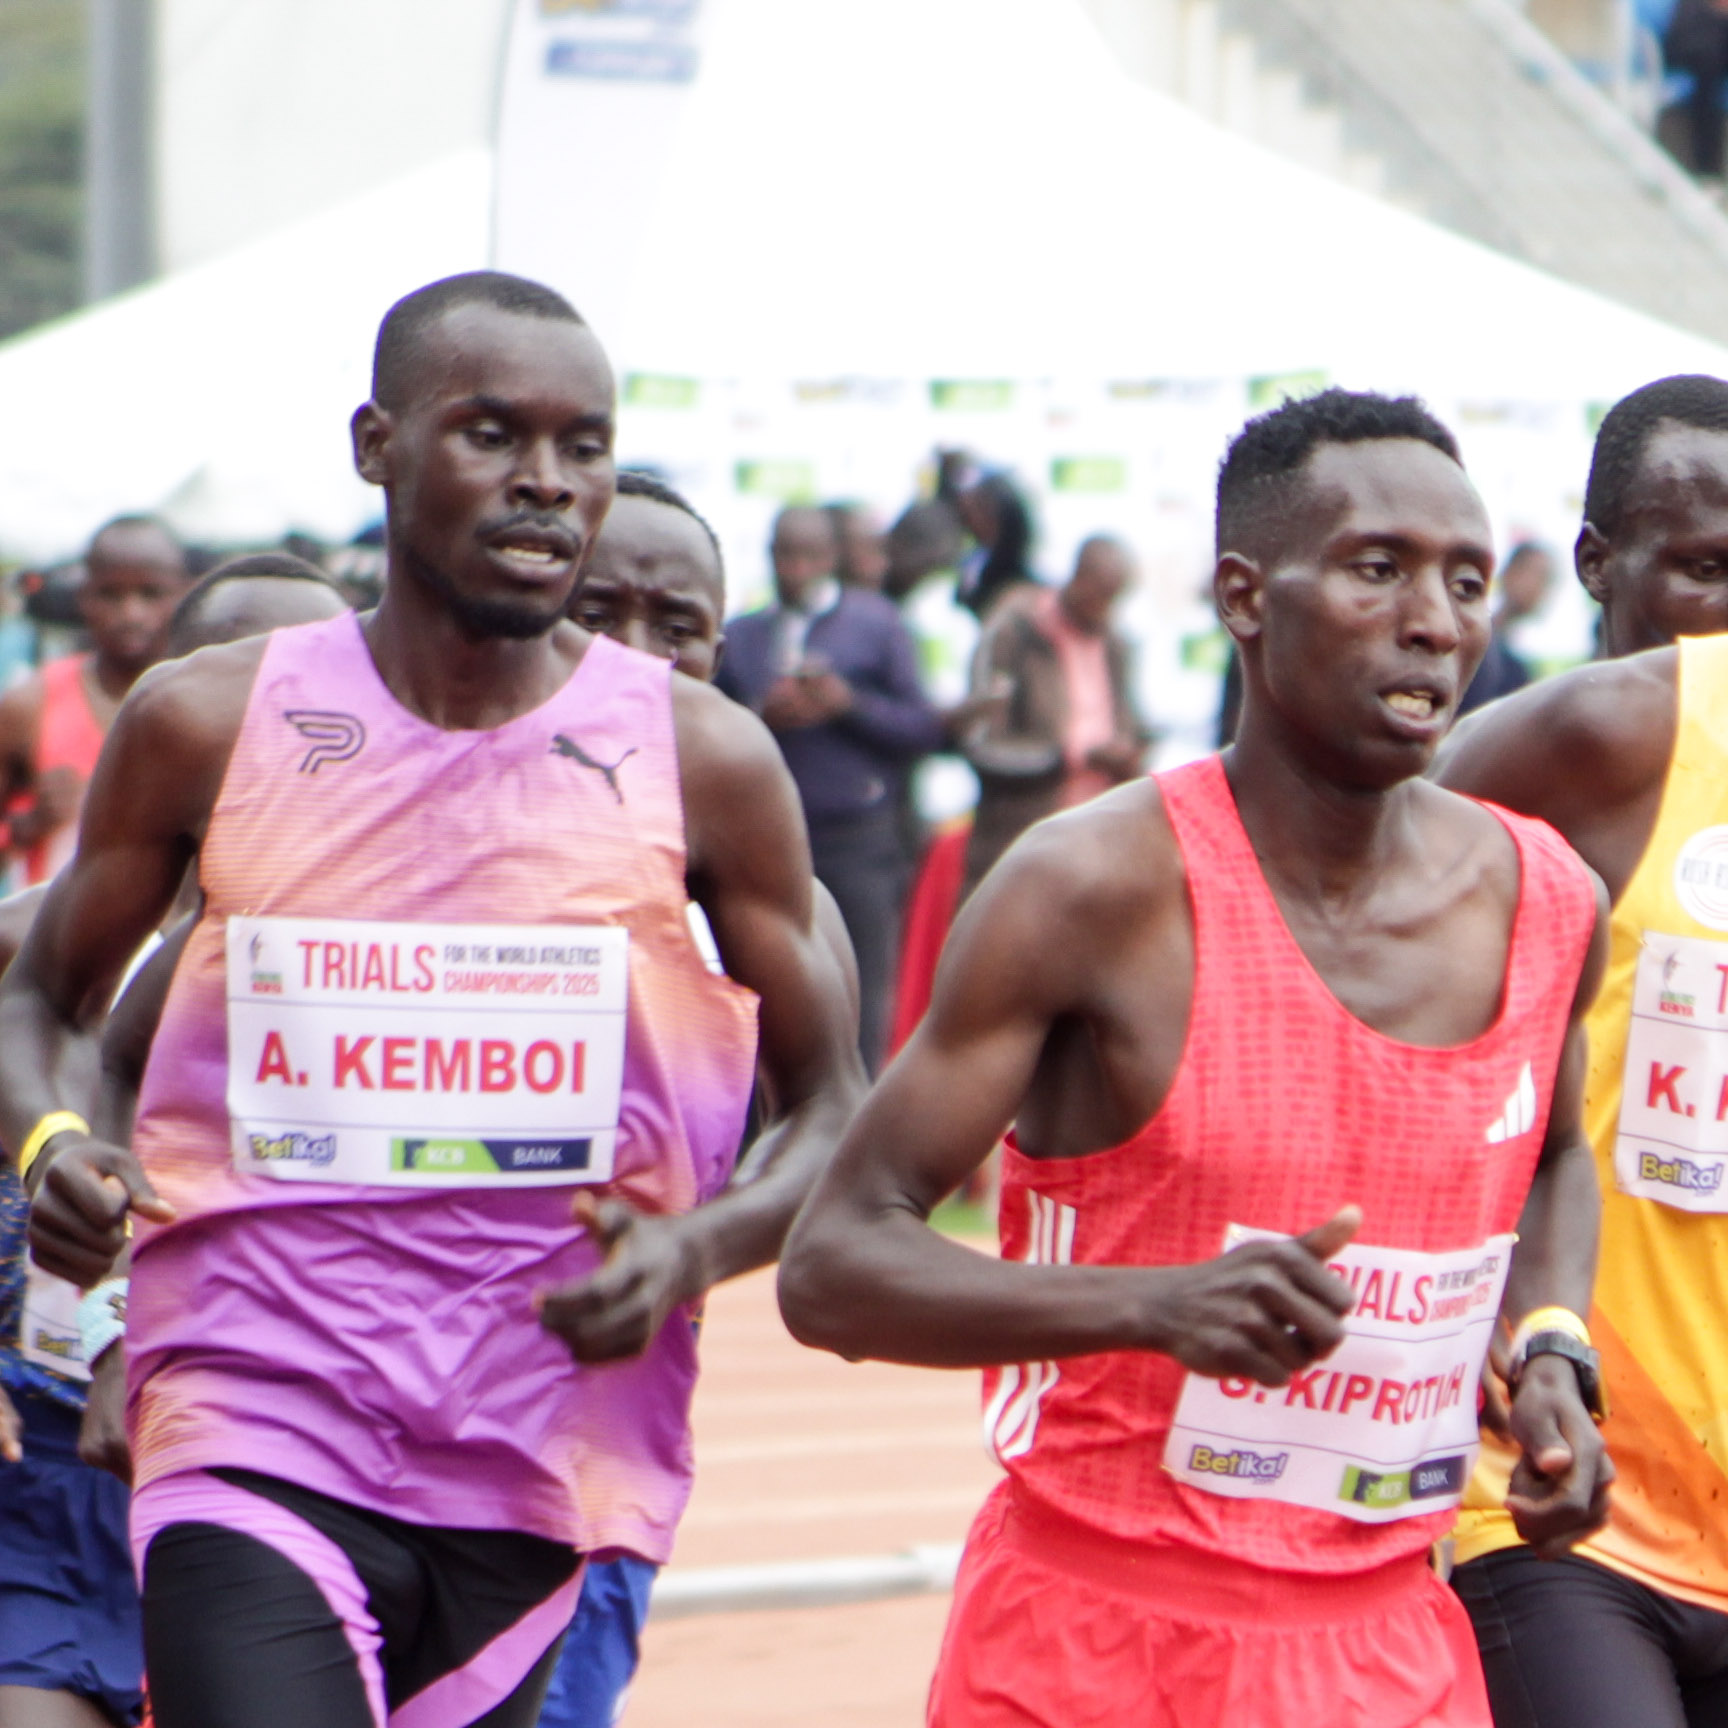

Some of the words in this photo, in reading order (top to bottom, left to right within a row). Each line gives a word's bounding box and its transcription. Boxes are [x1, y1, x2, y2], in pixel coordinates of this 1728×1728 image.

[298, 940, 436, 993] TRIALS
[445, 944, 466, 963] FOR
[471, 945, 491, 964] THE
[496, 946, 536, 965] WORLD
[256, 1031, 309, 1087] A.
[333, 1034, 586, 1094] KEMBOI
[1646, 1061, 1695, 1118] K.
[512, 1146, 563, 1166] BANK
[1639, 1151, 1723, 1192] Betika!
[1188, 1444, 1289, 1478] Betika!
[1418, 1468, 1449, 1490] BANK
